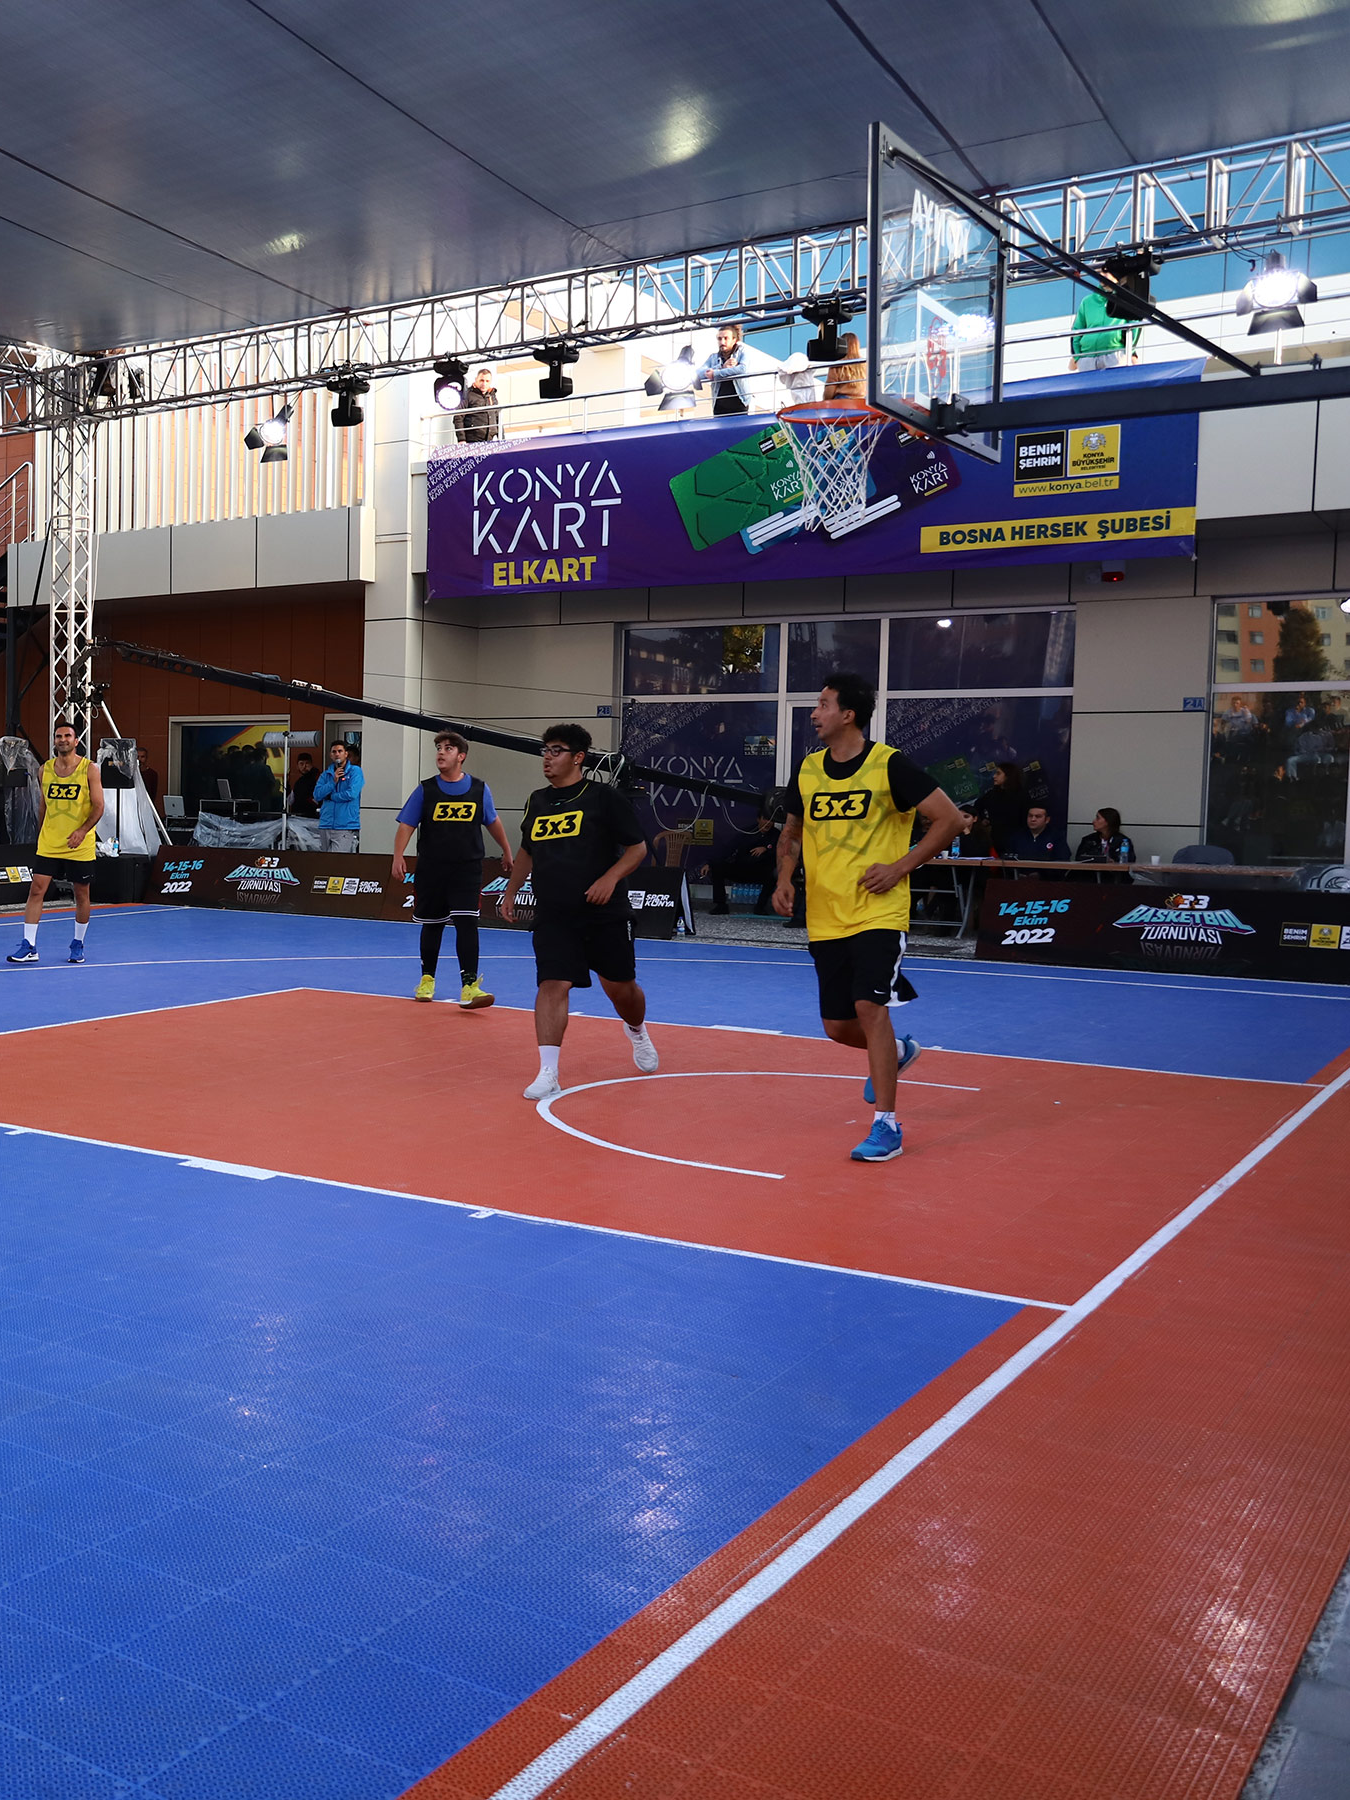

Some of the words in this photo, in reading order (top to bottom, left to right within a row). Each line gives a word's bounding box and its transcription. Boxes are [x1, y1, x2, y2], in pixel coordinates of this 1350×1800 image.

[827, 318, 835, 326] 2
[910, 461, 948, 485] KONYA
[912, 470, 949, 494] KART
[473, 460, 622, 507] KONYA
[1018, 478, 1114, 494] www.konya.bel.tr
[473, 498, 622, 556] KART
[939, 528, 1006, 546] BOSNA
[1010, 521, 1088, 541] HERSEK
[1096, 510, 1171, 539] ŞUBESİ
[493, 556, 597, 587] ELKART
[50, 785, 78, 798] 3x3
[436, 804, 473, 819] 3x3
[813, 794, 866, 818] 3x3
[534, 814, 578, 838] 3x3
[162, 859, 205, 872] 14-15-16
[226, 864, 300, 884] BASKETBOL
[170, 871, 190, 880] Ekim
[160, 880, 193, 894] 2022
[237, 879, 281, 893] TURNUVASI
[999, 899, 1071, 916] 14-15-16
[1013, 914, 1049, 926] Ekim
[1119, 904, 1254, 934] BASKETBOL
[1001, 928, 1056, 945] 2022
[1140, 925, 1223, 945] TURNUVASI
